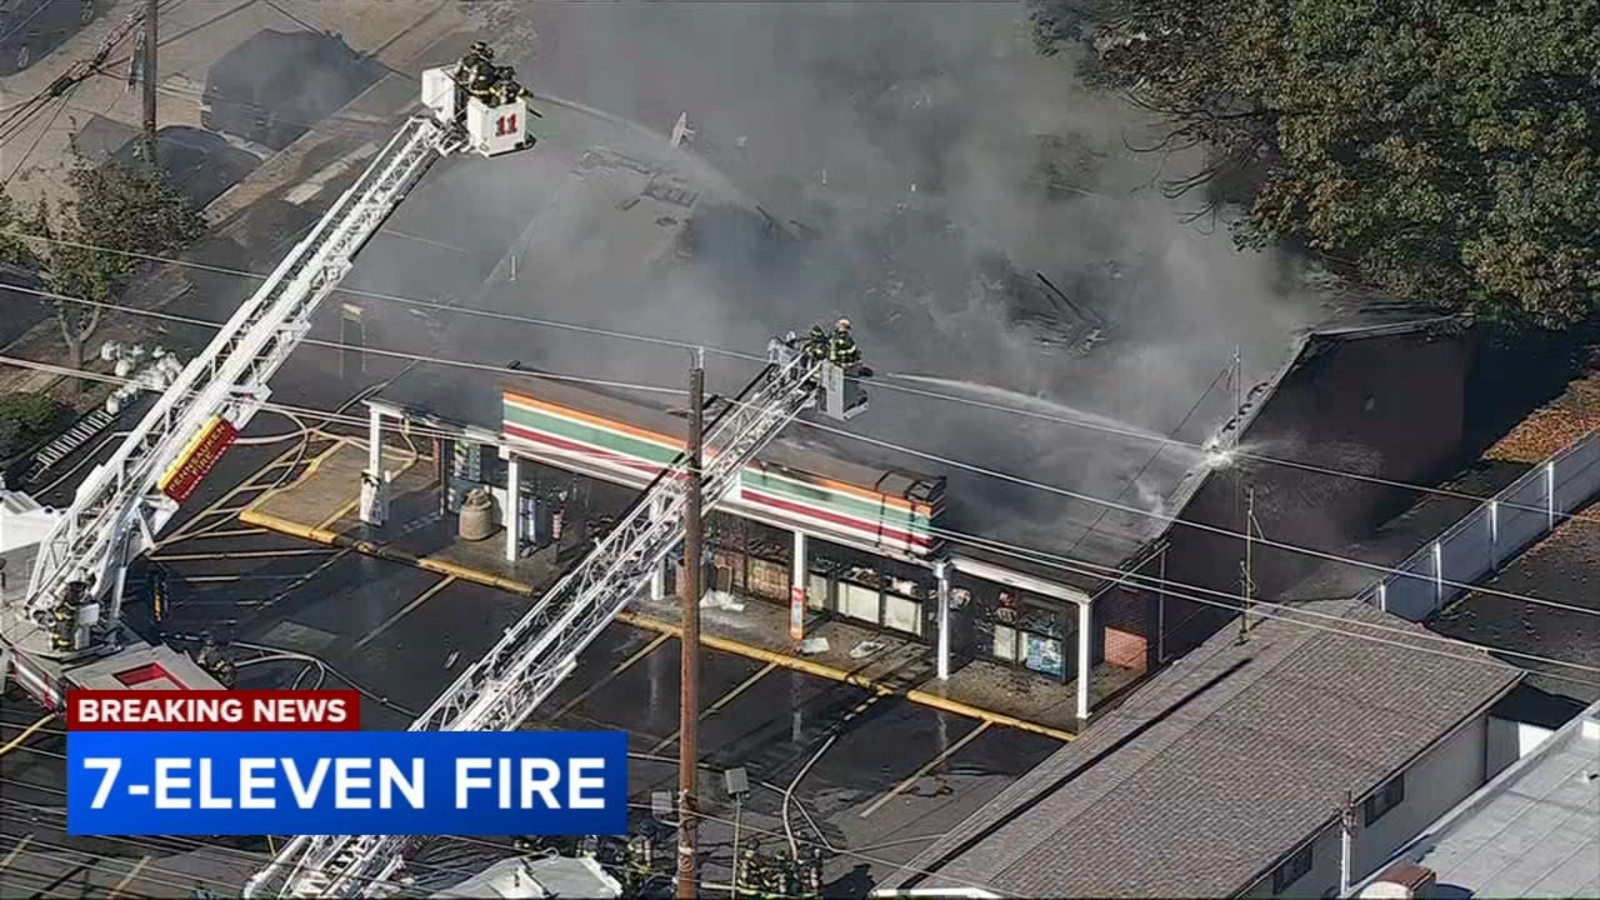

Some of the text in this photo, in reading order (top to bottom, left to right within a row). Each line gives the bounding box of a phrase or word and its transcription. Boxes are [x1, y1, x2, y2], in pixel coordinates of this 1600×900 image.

[495, 113, 518, 137] 11
[168, 424, 226, 492] PENNSAUKEN
[191, 451, 214, 476] FIRE
